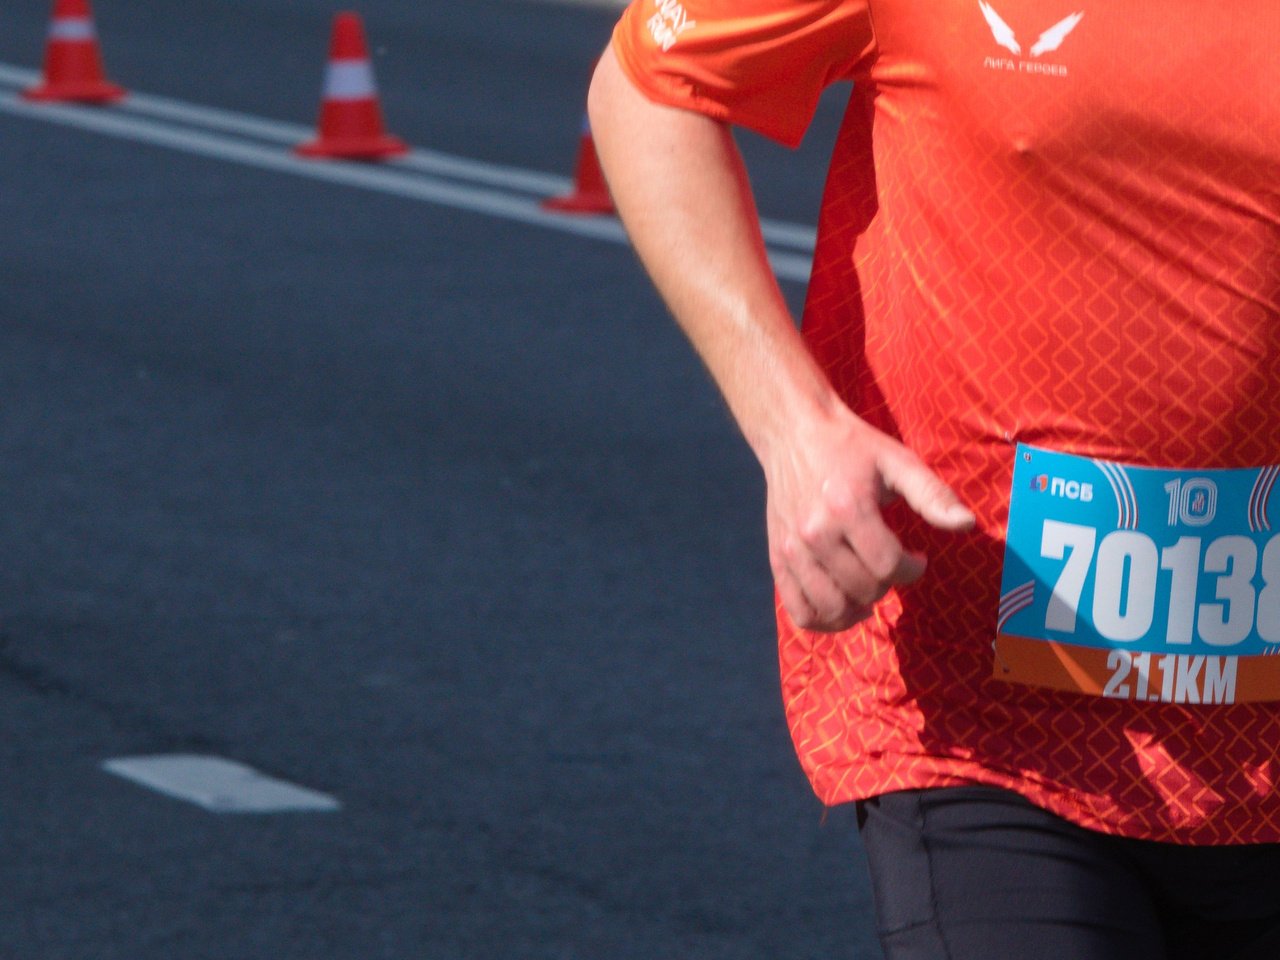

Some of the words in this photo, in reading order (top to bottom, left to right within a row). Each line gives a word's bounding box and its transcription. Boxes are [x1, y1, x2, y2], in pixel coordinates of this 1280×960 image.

[984, 56, 1015, 71] ЛИГА
[1019, 60, 1067, 77] ГЕРОЕВ
[1051, 477, 1093, 502] ПСБ
[1164, 477, 1218, 527] 10
[1103, 648, 1238, 704] 21.1KM
